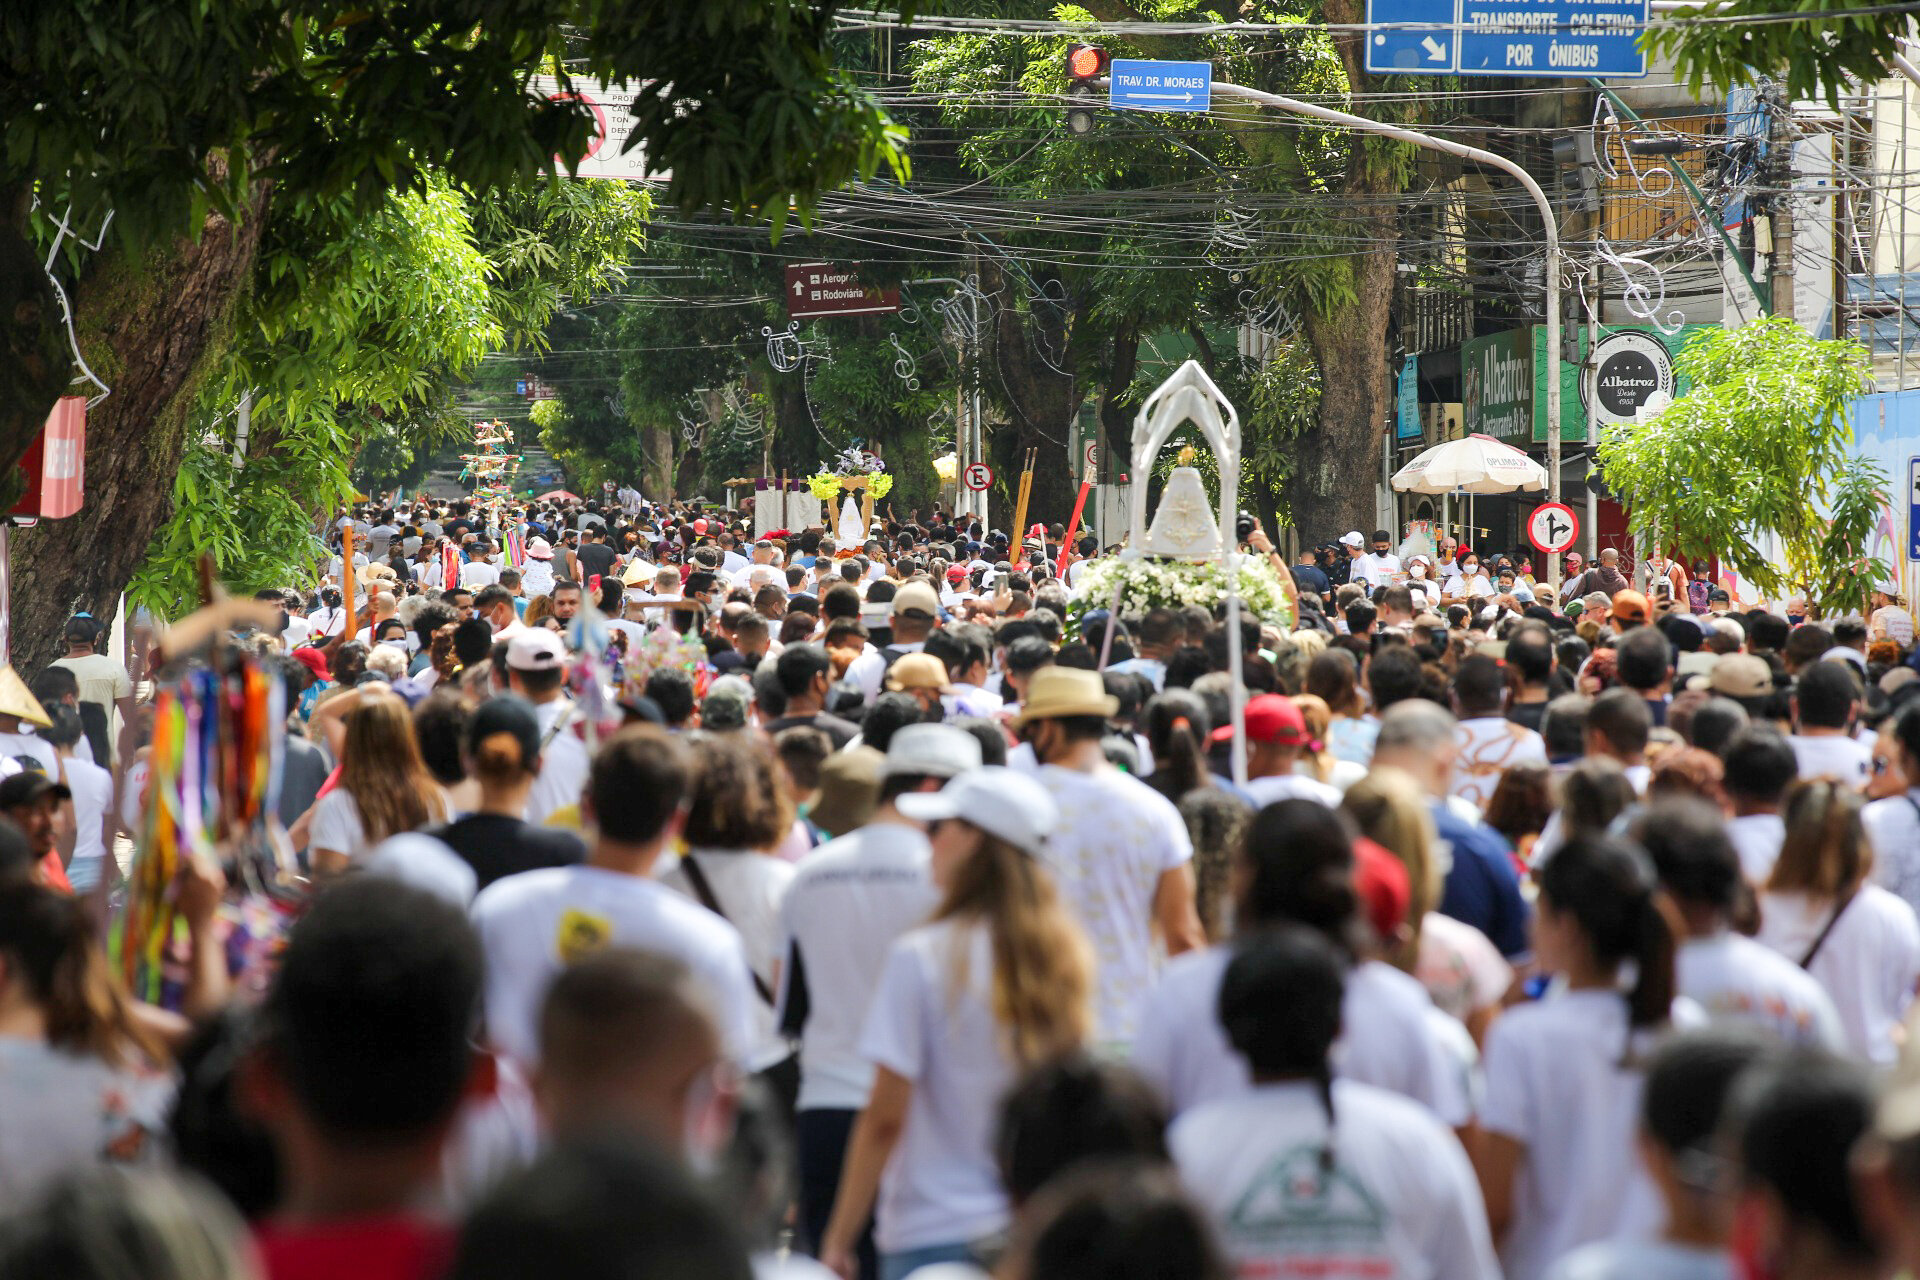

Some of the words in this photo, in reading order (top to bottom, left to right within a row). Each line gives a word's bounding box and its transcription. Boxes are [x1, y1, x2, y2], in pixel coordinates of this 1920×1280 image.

[1471, 12, 1558, 35] TRANSPORTE
[1570, 14, 1635, 36] COLETIVO
[1506, 44, 1533, 66] POR
[1549, 39, 1598, 67] ÔNIBUS
[1118, 75, 1143, 86] TRAV.
[1145, 76, 1161, 87] DR.
[1164, 77, 1204, 88] MORAES
[823, 288, 863, 300] Rodoviária
[1483, 344, 1529, 406] Albatroz
[1600, 376, 1654, 387] Albatroz
[1486, 458, 1518, 467] OPLIMA
